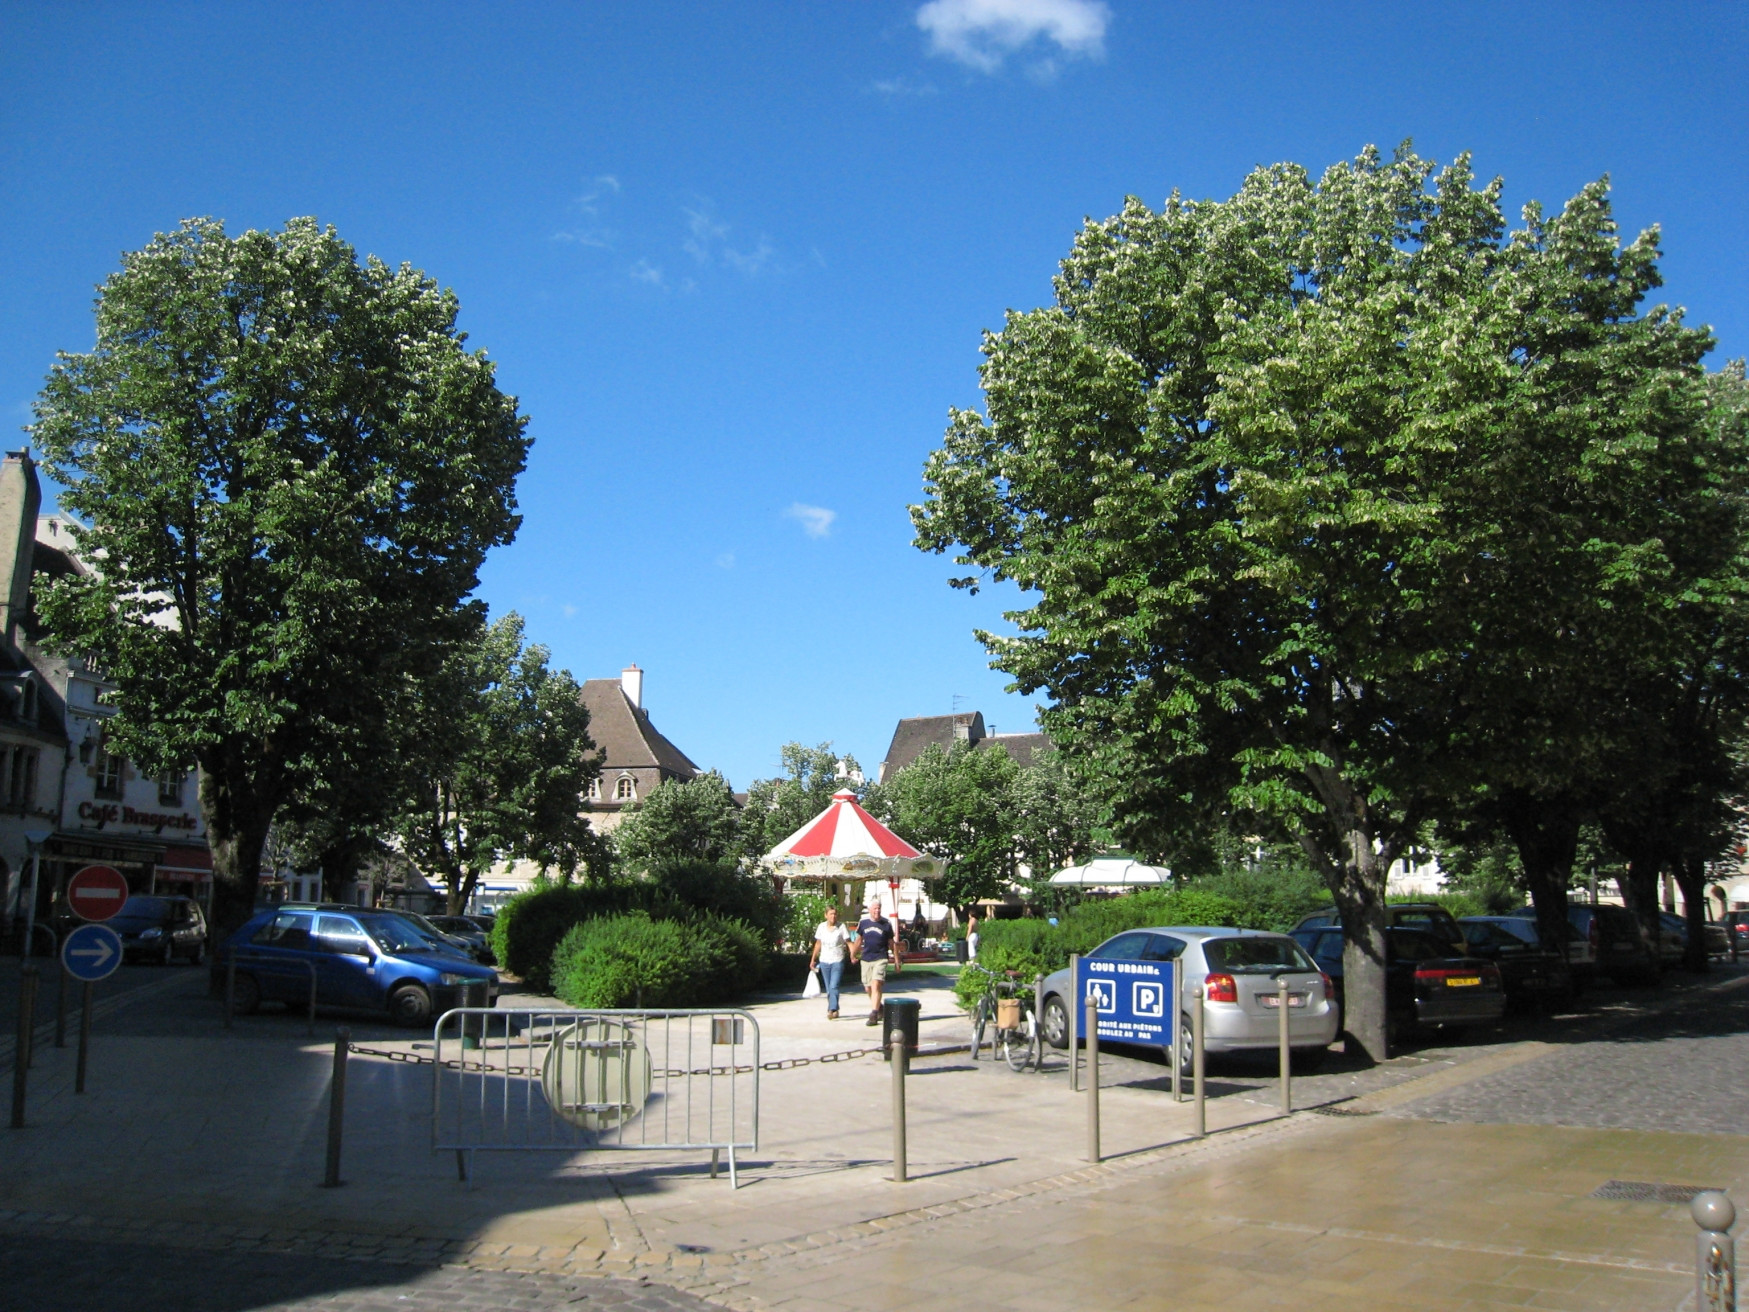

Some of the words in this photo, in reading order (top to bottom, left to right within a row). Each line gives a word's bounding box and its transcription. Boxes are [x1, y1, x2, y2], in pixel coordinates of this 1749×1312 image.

[78, 801, 118, 825] Café
[122, 806, 197, 829] Brasserie
[1090, 962, 1115, 972] COUR
[1133, 1023, 1162, 1032] PIÉTONS
